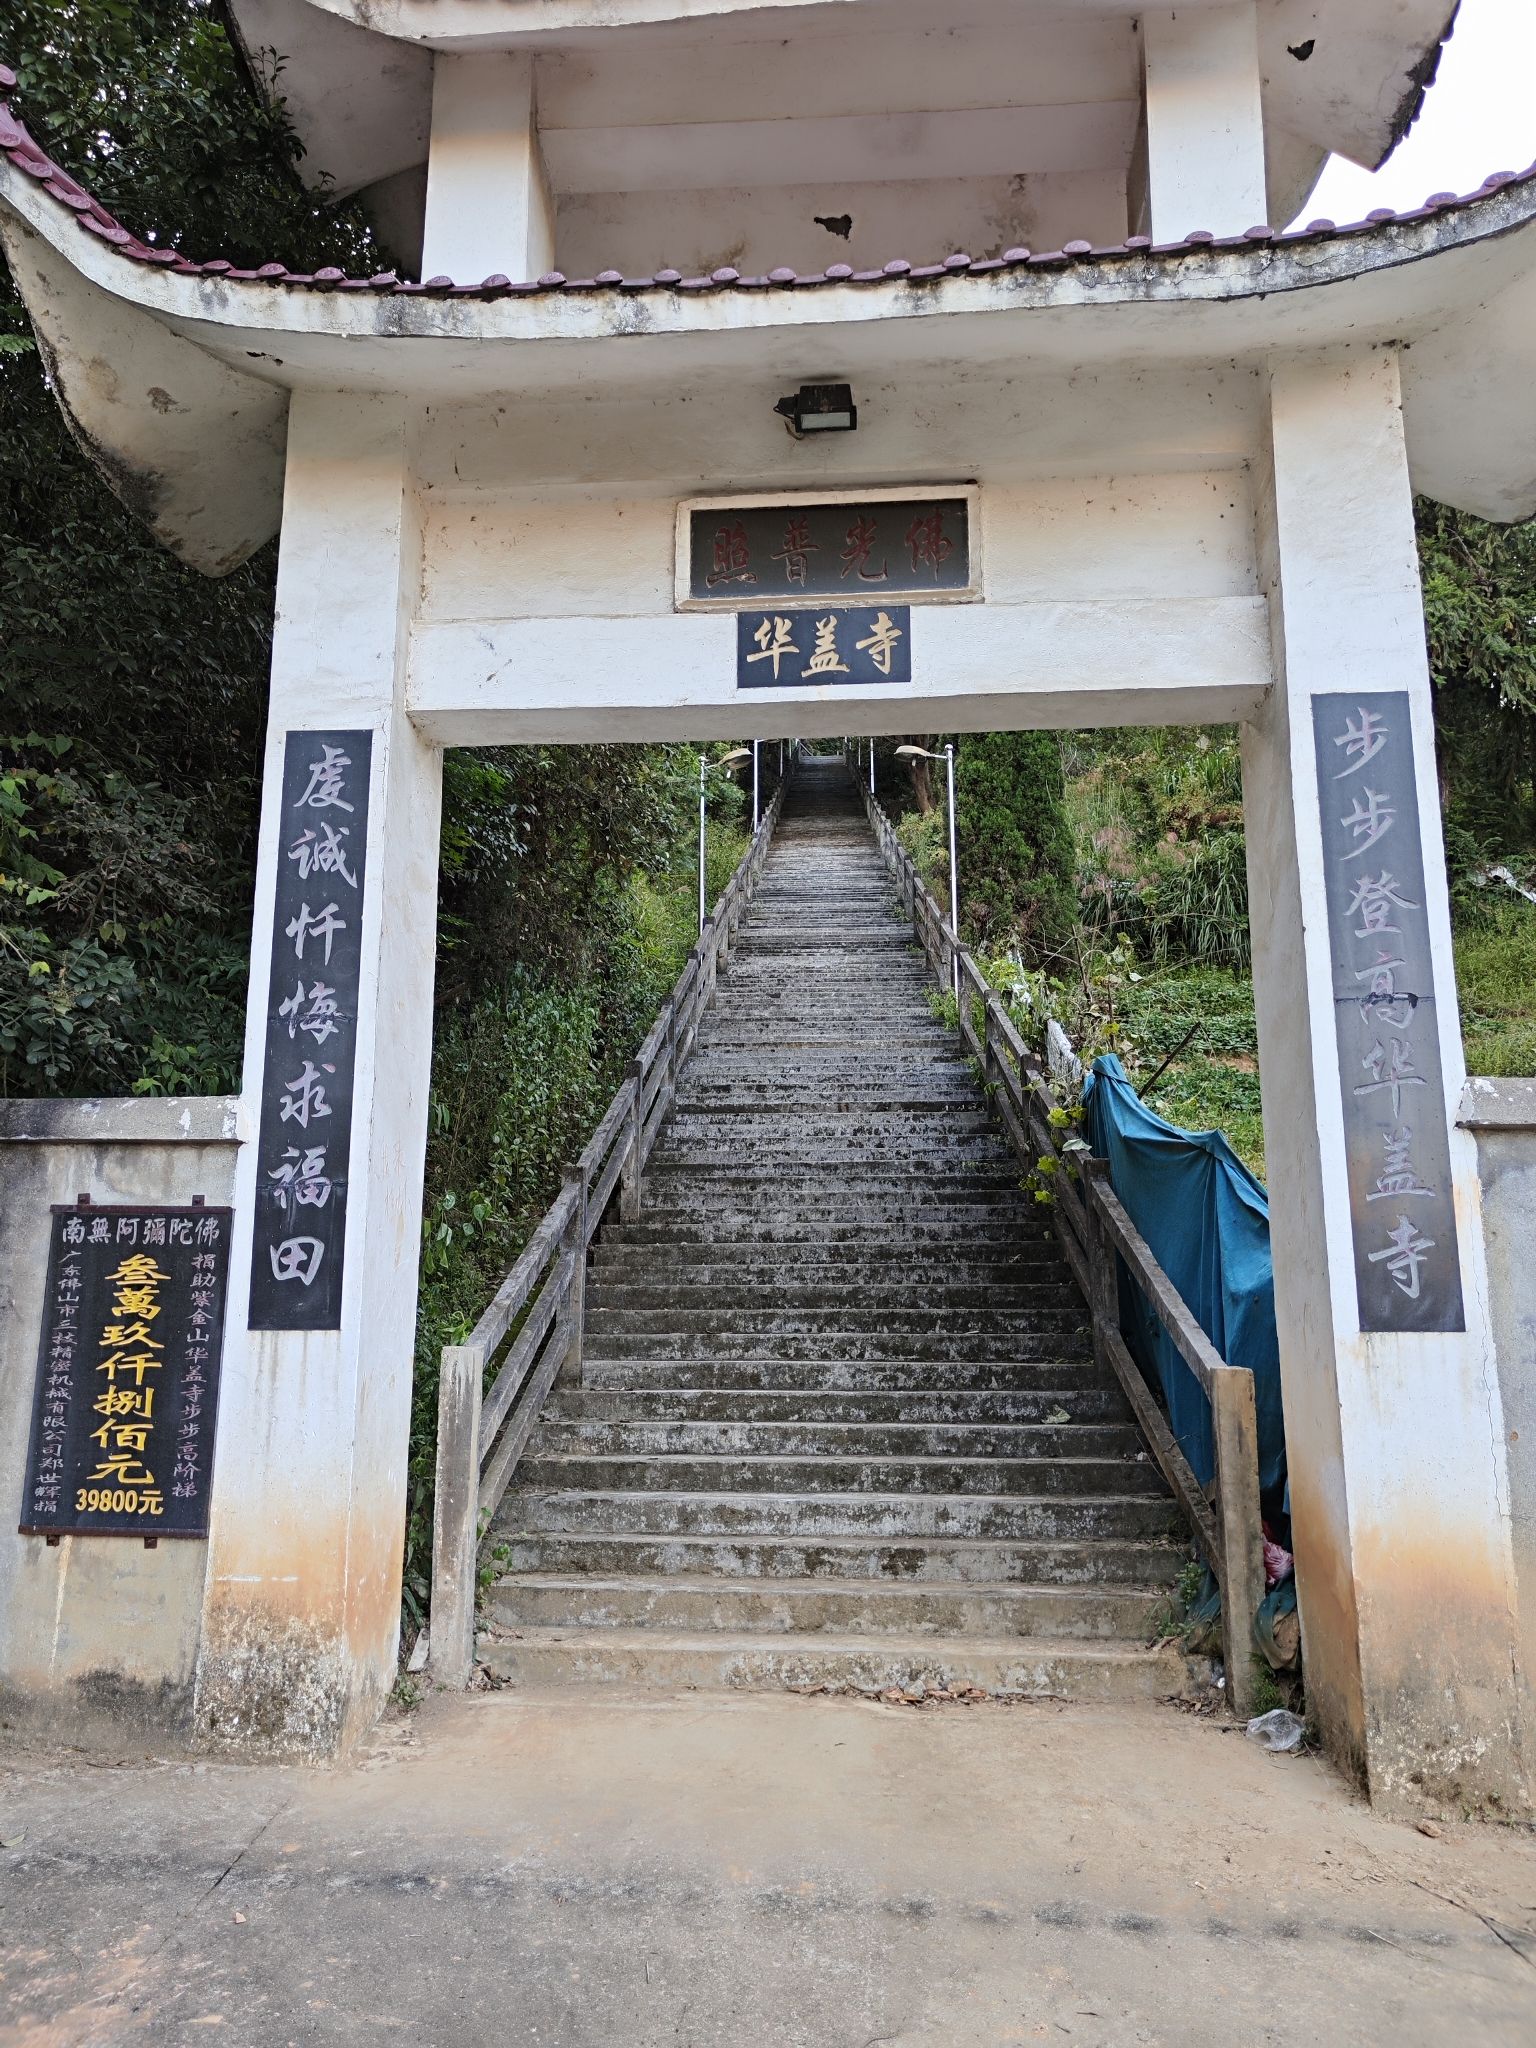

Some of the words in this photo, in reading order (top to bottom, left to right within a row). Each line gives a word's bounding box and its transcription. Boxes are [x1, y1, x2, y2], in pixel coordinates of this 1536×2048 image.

[746, 611, 903, 680] 华盖寺
[1331, 705, 1437, 1299] 步步登高华盖寺
[62, 1216, 220, 1247] 南無阿彌陀佛
[171, 1252, 217, 1498] 捐助紫金山华盖寺步步高阶梯
[75, 1488, 165, 1515] 39800元
